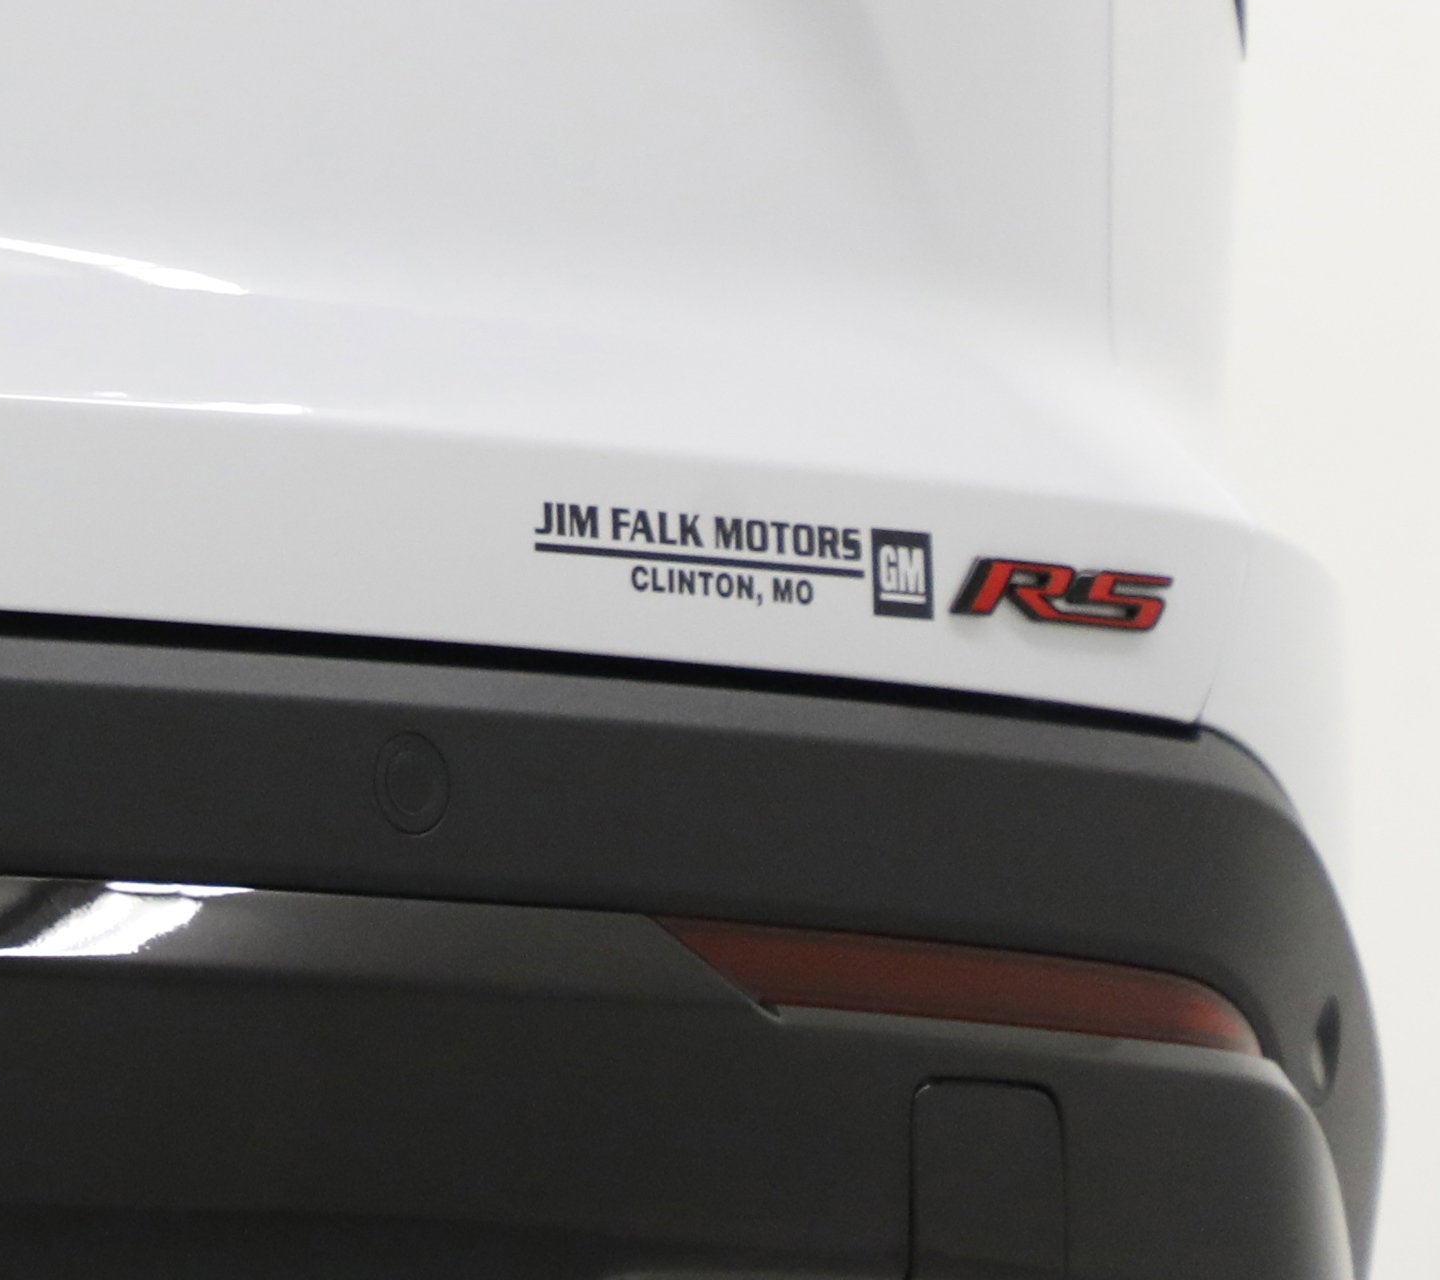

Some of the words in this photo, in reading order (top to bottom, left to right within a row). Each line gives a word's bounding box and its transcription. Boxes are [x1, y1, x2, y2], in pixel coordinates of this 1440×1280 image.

[535, 502, 598, 538] JIM
[611, 508, 701, 548] FALK
[715, 518, 861, 560] MOTORS
[631, 567, 763, 607] CLINTON,
[773, 576, 814, 605] MO
[880, 544, 925, 594] GM
[950, 556, 1173, 632] RS
